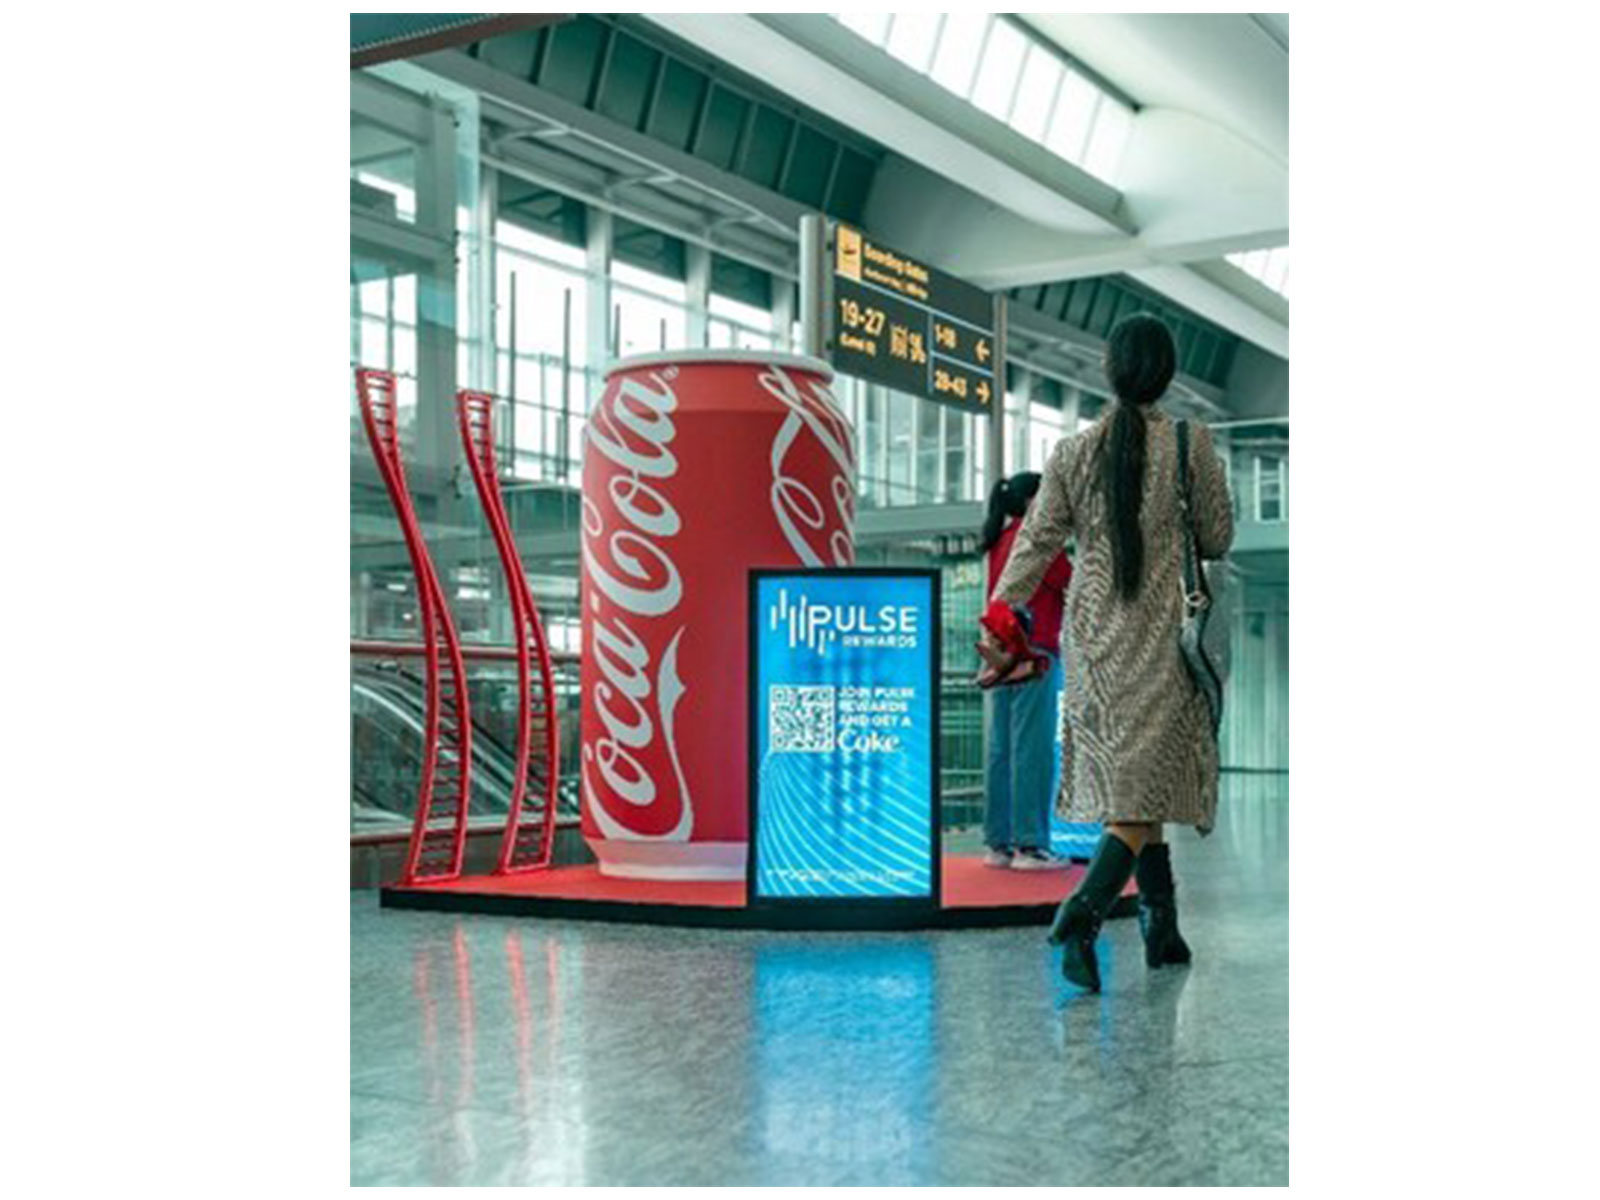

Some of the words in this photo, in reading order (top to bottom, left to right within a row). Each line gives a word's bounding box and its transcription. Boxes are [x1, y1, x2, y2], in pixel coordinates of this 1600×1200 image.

[841, 299, 885, 336] 19-27
[808, 605, 918, 648] PULSE
[843, 635, 917, 648] REWARDS
[838, 686, 871, 699] JOIN
[874, 687, 914, 699] PULSE
[838, 700, 908, 713] REWARDS
[838, 714, 869, 727] AND
[872, 714, 898, 728] GET
[901, 715, 912, 728] A
[838, 729, 900, 752] Coke
